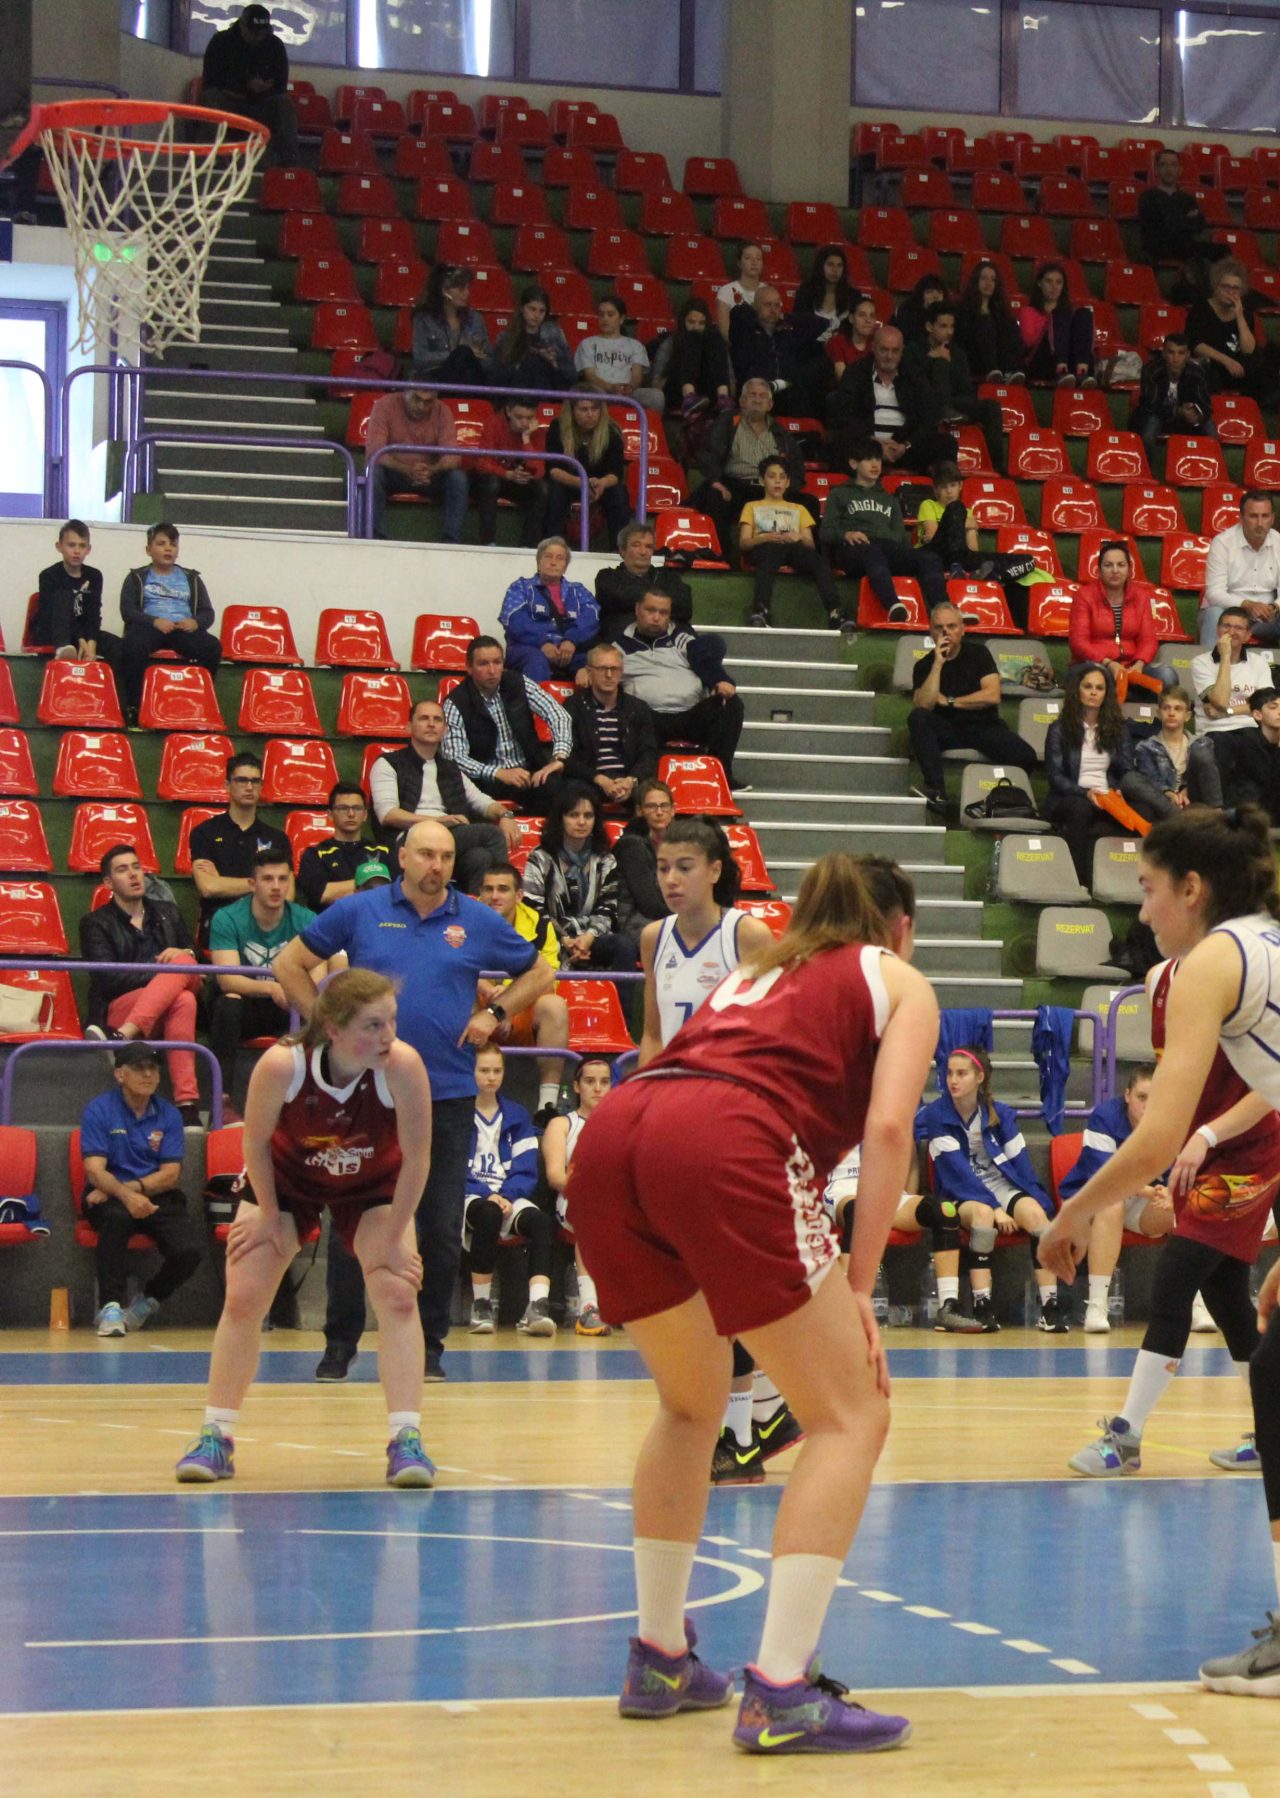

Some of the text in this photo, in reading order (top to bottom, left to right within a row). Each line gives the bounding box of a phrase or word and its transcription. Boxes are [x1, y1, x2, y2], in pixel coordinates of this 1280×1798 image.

[1017, 852, 1054, 862] REZERVAT
[1056, 924, 1095, 934] REZERVAT
[674, 1002, 693, 1025] 7
[480, 1153, 497, 1174] 12
